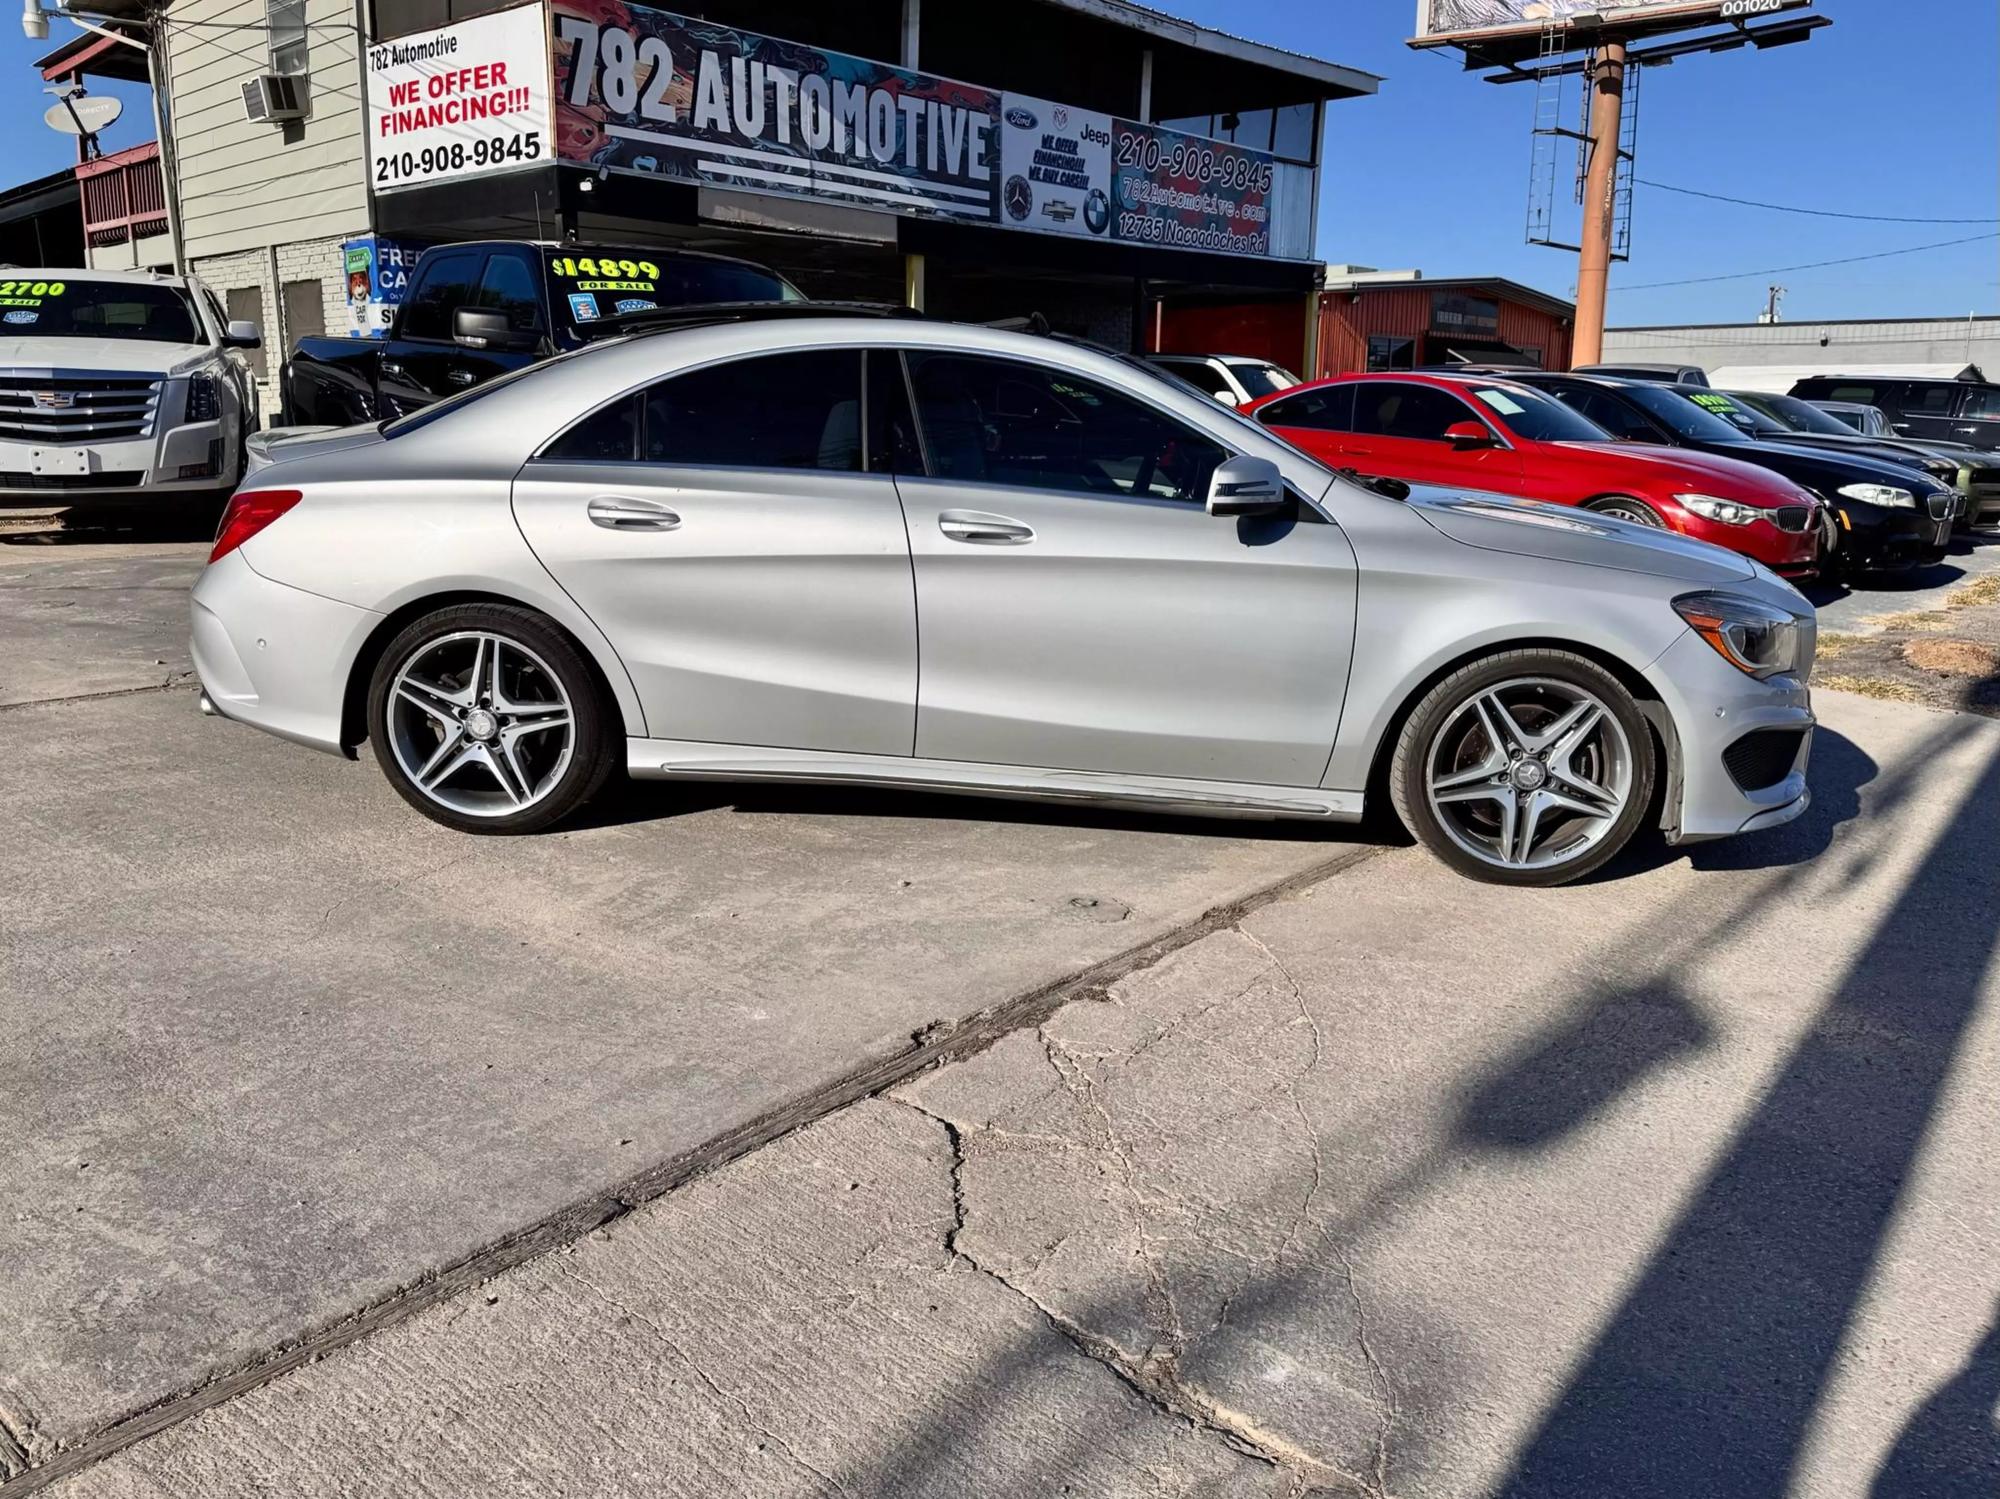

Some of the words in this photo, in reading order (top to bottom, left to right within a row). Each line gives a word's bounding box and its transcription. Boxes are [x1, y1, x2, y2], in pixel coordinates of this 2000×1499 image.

[1723, 0, 1780, 15] 001020
[370, 50, 389, 72] 782
[391, 35, 457, 67] Automotive
[389, 84, 421, 107] WE
[427, 62, 507, 98] OFFER
[555, 17, 677, 123] 782
[693, 48, 991, 181] AUTOMOTIVE
[381, 87, 530, 137] FINANCING!!!
[1010, 111, 1032, 127] Ford
[1080, 123, 1110, 148] Jeep
[376, 132, 541, 182] 210-908-9845
[1117, 132, 1274, 195] 210-908-9845
[1123, 177, 1266, 222] 782Automotive.com
[1119, 212, 1164, 241] 12735
[1249, 232, 1267, 254] Rd
[552, 257, 660, 280] $14899
[580, 282, 609, 290] FOR
[616, 282, 652, 290] SALE
